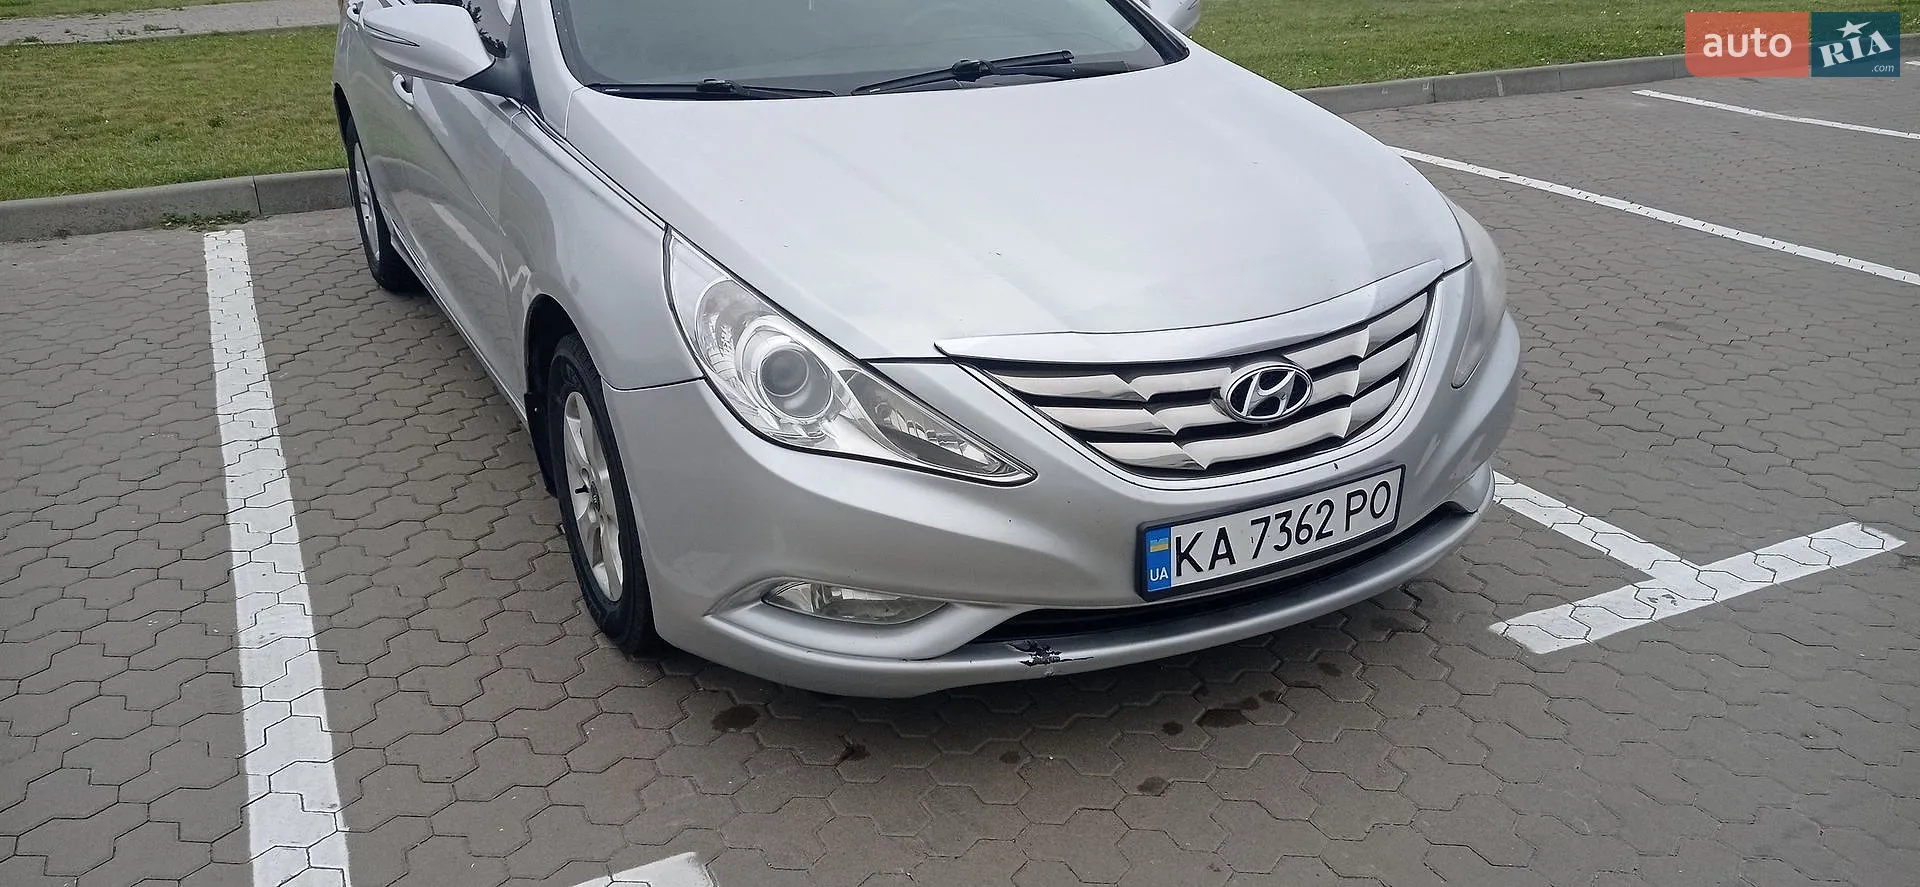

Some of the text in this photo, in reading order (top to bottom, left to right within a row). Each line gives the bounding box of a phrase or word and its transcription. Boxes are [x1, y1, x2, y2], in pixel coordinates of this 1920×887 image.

[1175, 480, 1392, 577] KA 7362 PO
[1150, 566, 1169, 581] UA
